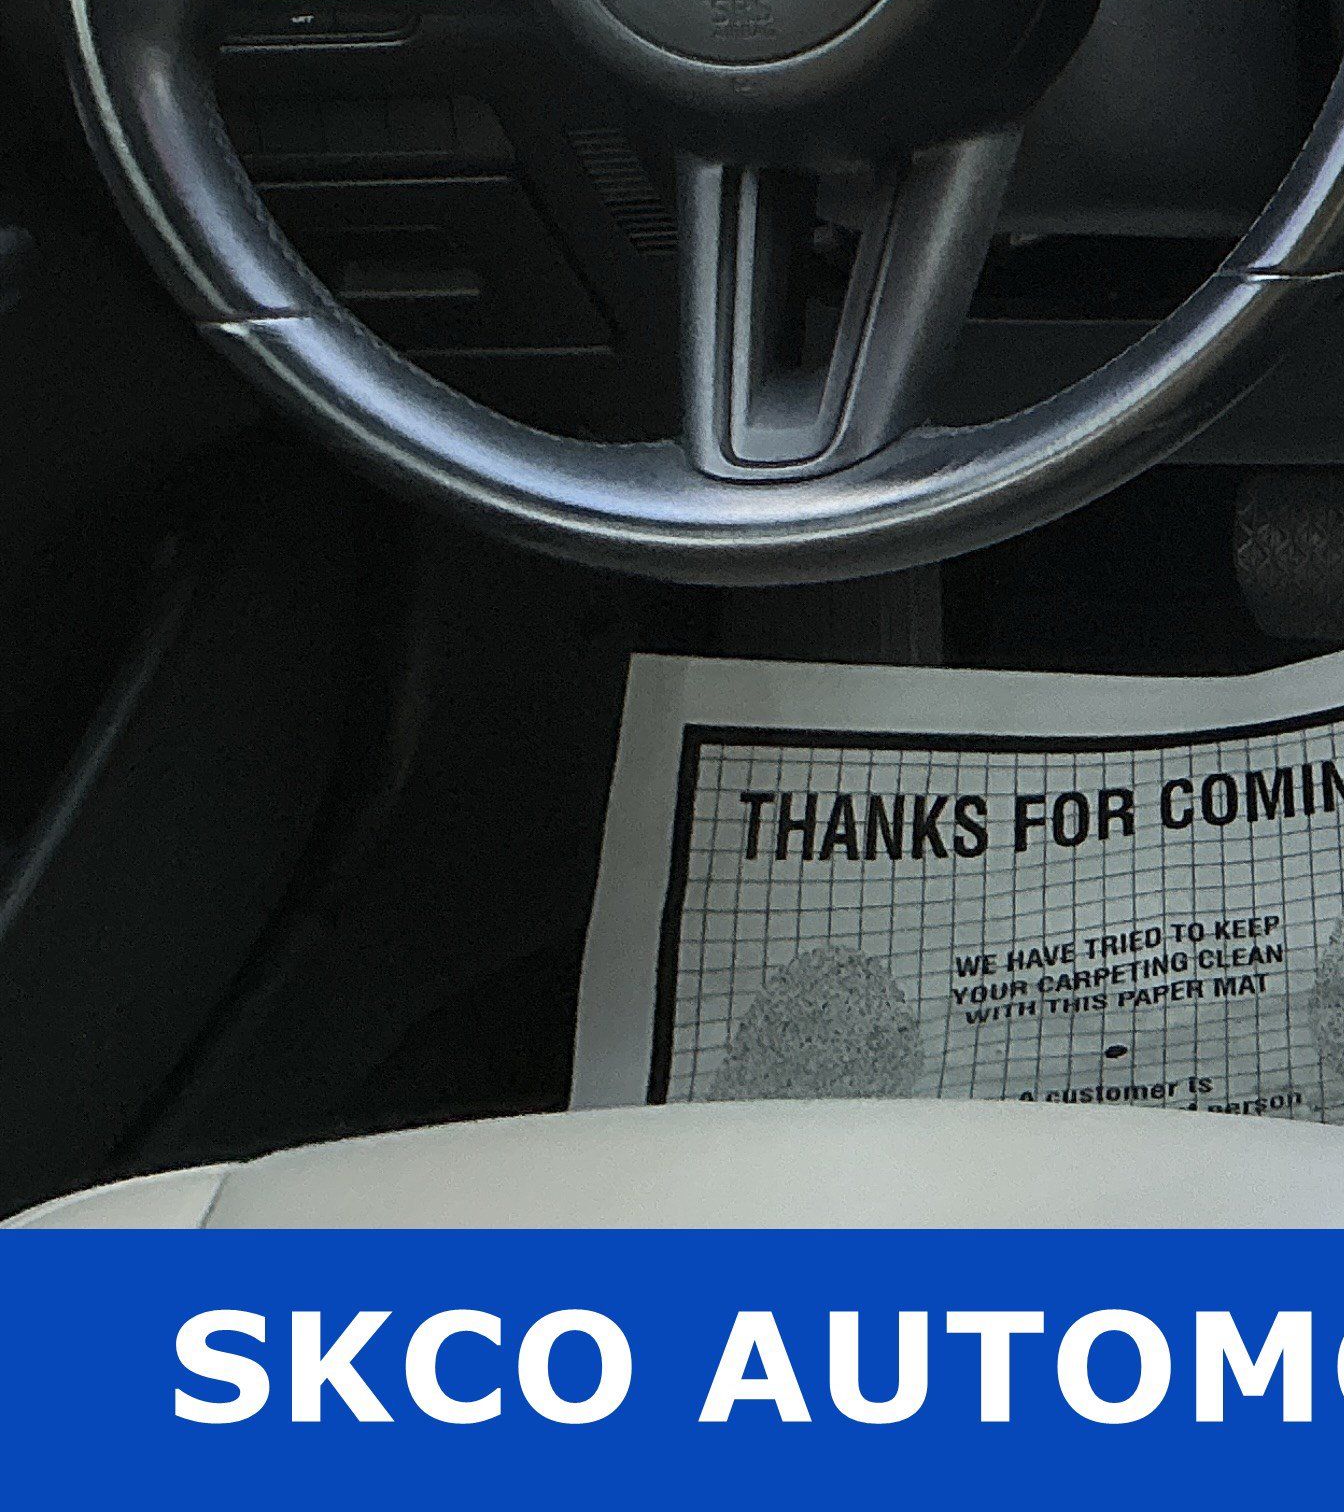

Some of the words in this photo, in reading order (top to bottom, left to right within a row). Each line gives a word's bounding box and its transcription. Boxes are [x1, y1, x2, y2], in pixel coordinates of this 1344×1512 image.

[741, 791, 989, 862] THANKS
[1013, 788, 1135, 852] FOR
[951, 980, 1028, 1007] YOUR
[1037, 951, 1189, 994] CARPETING
[1197, 944, 1284, 969] CLEAN
[956, 952, 997, 978] WE
[1006, 943, 1076, 973] HAVE
[1084, 927, 1162, 959] TRIED
[1170, 920, 1205, 943] TO
[1215, 914, 1281, 941] KEEP
[964, 1000, 1036, 1026] WITH
[1050, 994, 1108, 1015] THIS
[1118, 979, 1203, 1007] PAPER
[1213, 972, 1269, 997] MAT
[1045, 1081, 1178, 1104] customer
[1187, 1076, 1214, 1094] is
